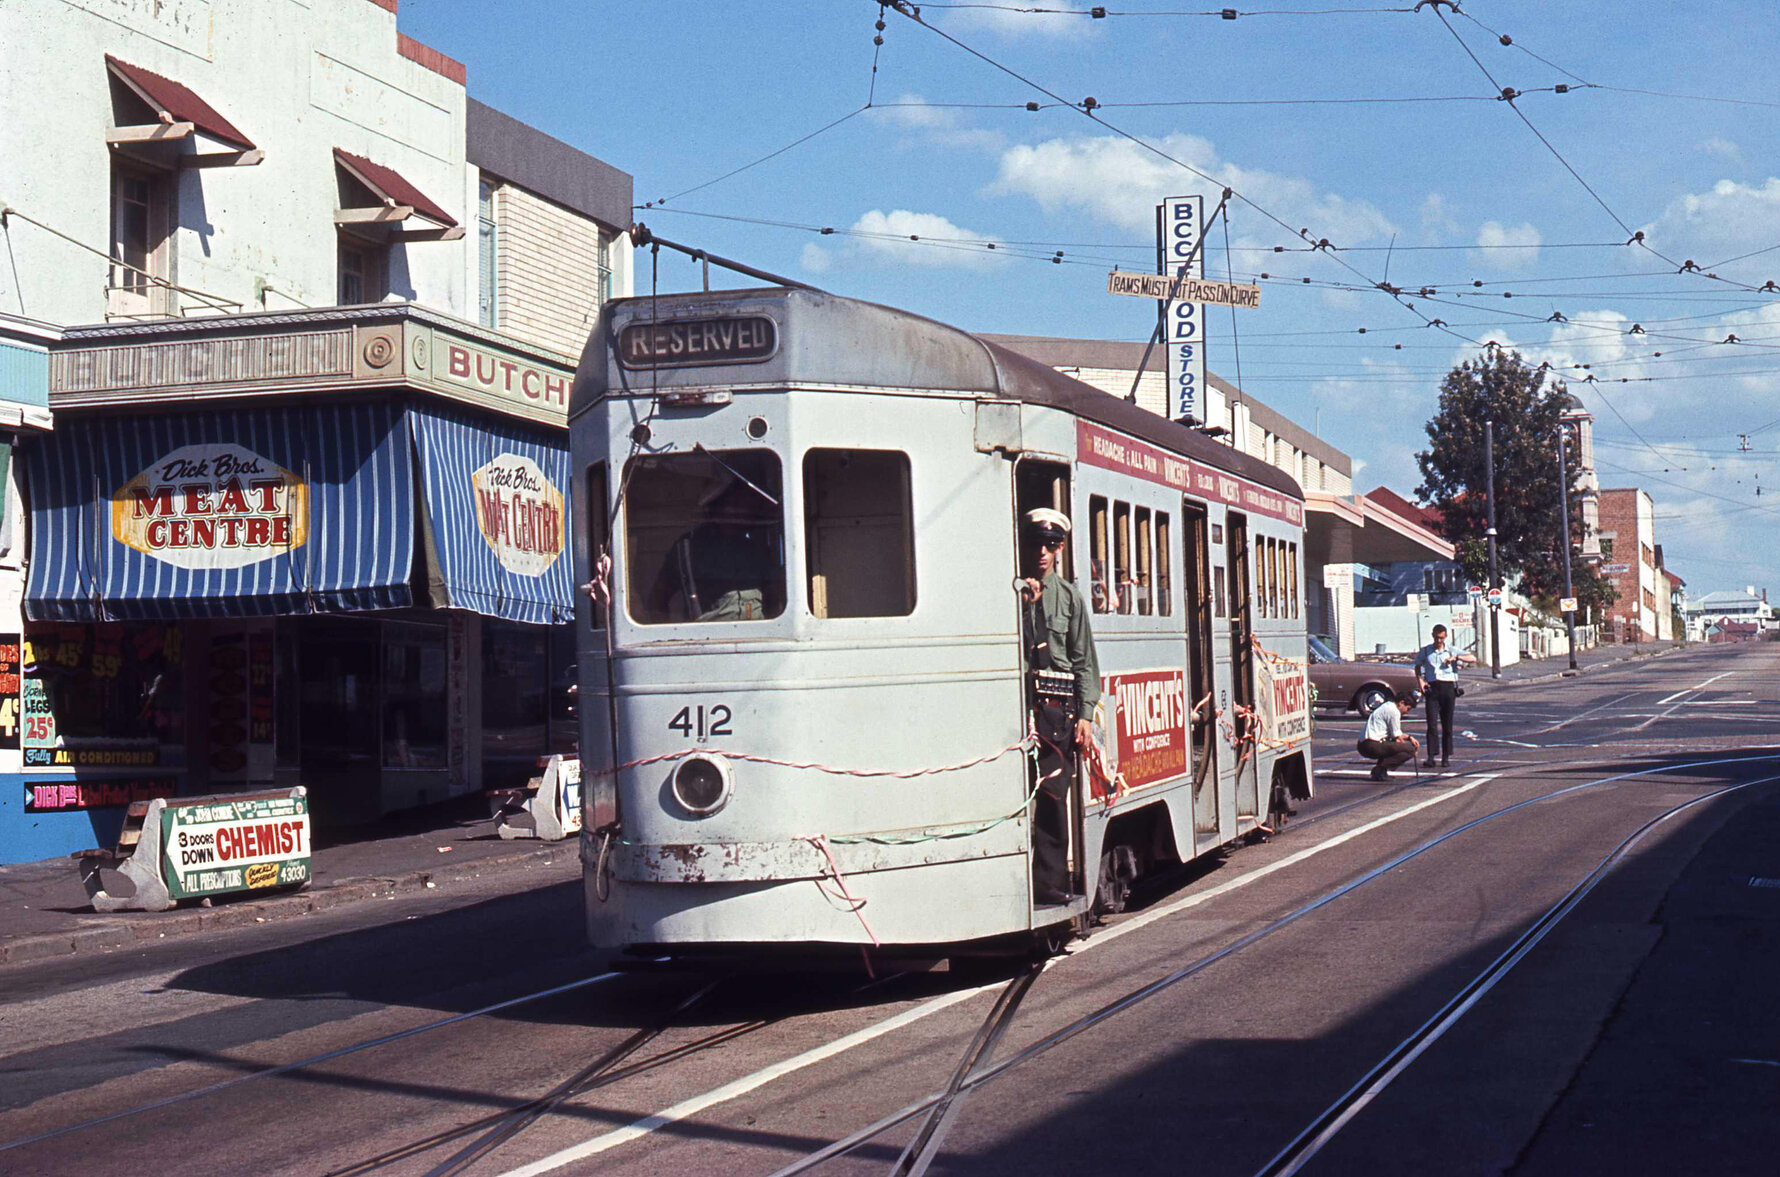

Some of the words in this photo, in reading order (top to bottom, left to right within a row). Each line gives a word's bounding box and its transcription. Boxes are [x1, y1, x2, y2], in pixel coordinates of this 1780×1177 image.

[1174, 203, 1193, 257] BCC
[1108, 273, 1140, 294] TRAMS
[1141, 277, 1167, 296] MUST
[1188, 282, 1216, 301] PASS
[1216, 285, 1230, 303] ON
[1231, 286, 1260, 307] CURVE
[1175, 265, 1196, 339] FOD
[631, 317, 767, 356] RESERVED
[449, 345, 572, 406] BUTCH
[1178, 344, 1195, 420] STORE
[162, 459, 209, 481] Dick
[211, 454, 265, 477] Bros.
[513, 466, 541, 492] Bros.
[131, 475, 284, 519] MEAT
[146, 515, 292, 550] CENTRE
[25, 699, 51, 713] LEGS
[668, 704, 733, 738] 412
[1122, 672, 1184, 737] VINCENT'S
[26, 748, 51, 765] Fully
[55, 750, 74, 763] AIR
[79, 750, 155, 765] CONDITIONED
[33, 786, 58, 808] DICK
[178, 831, 188, 847] 3
[190, 834, 214, 846] DOORS
[216, 821, 303, 861] CHEMIST
[182, 848, 214, 866] DOWN
[280, 865, 306, 883] 43030
[186, 874, 199, 892] ALL
